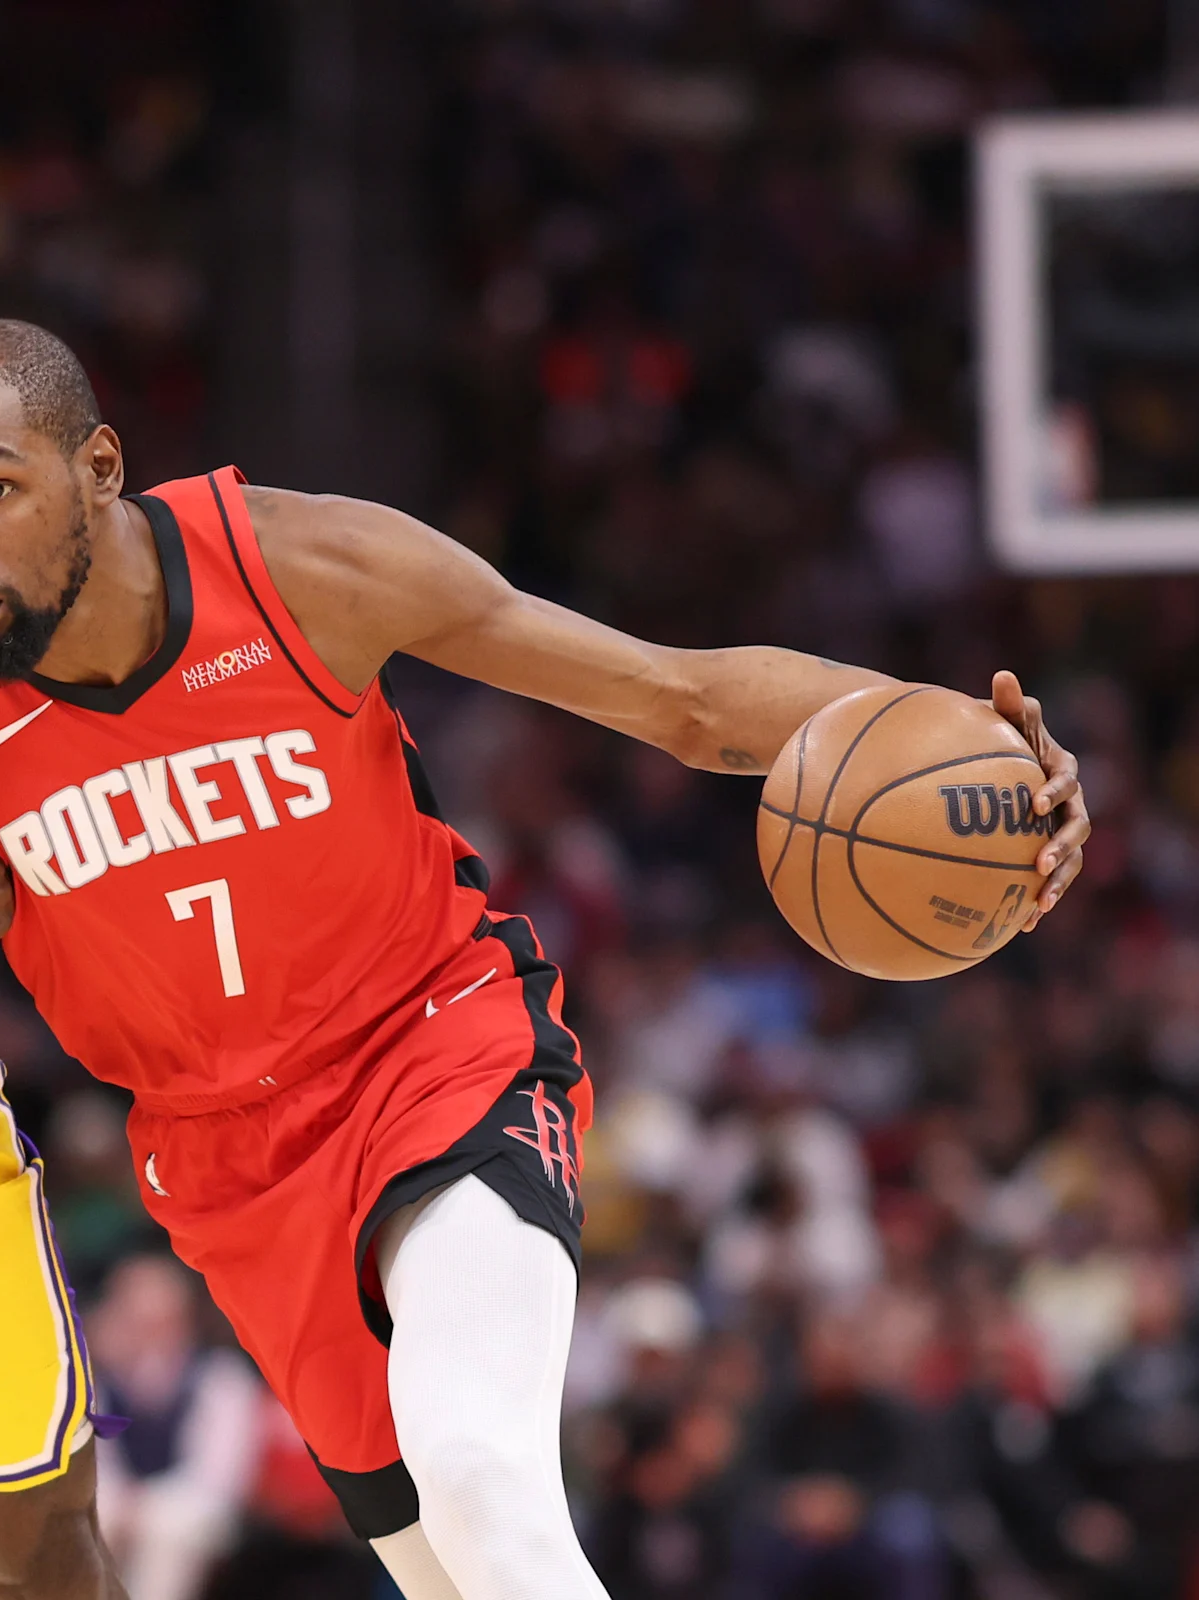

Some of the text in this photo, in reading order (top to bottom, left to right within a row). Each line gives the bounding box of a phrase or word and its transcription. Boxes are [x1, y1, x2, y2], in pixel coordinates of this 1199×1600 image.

[181, 637, 267, 683] MEMORIAL
[183, 645, 273, 693] HERMANN
[164, 877, 245, 998] 7
